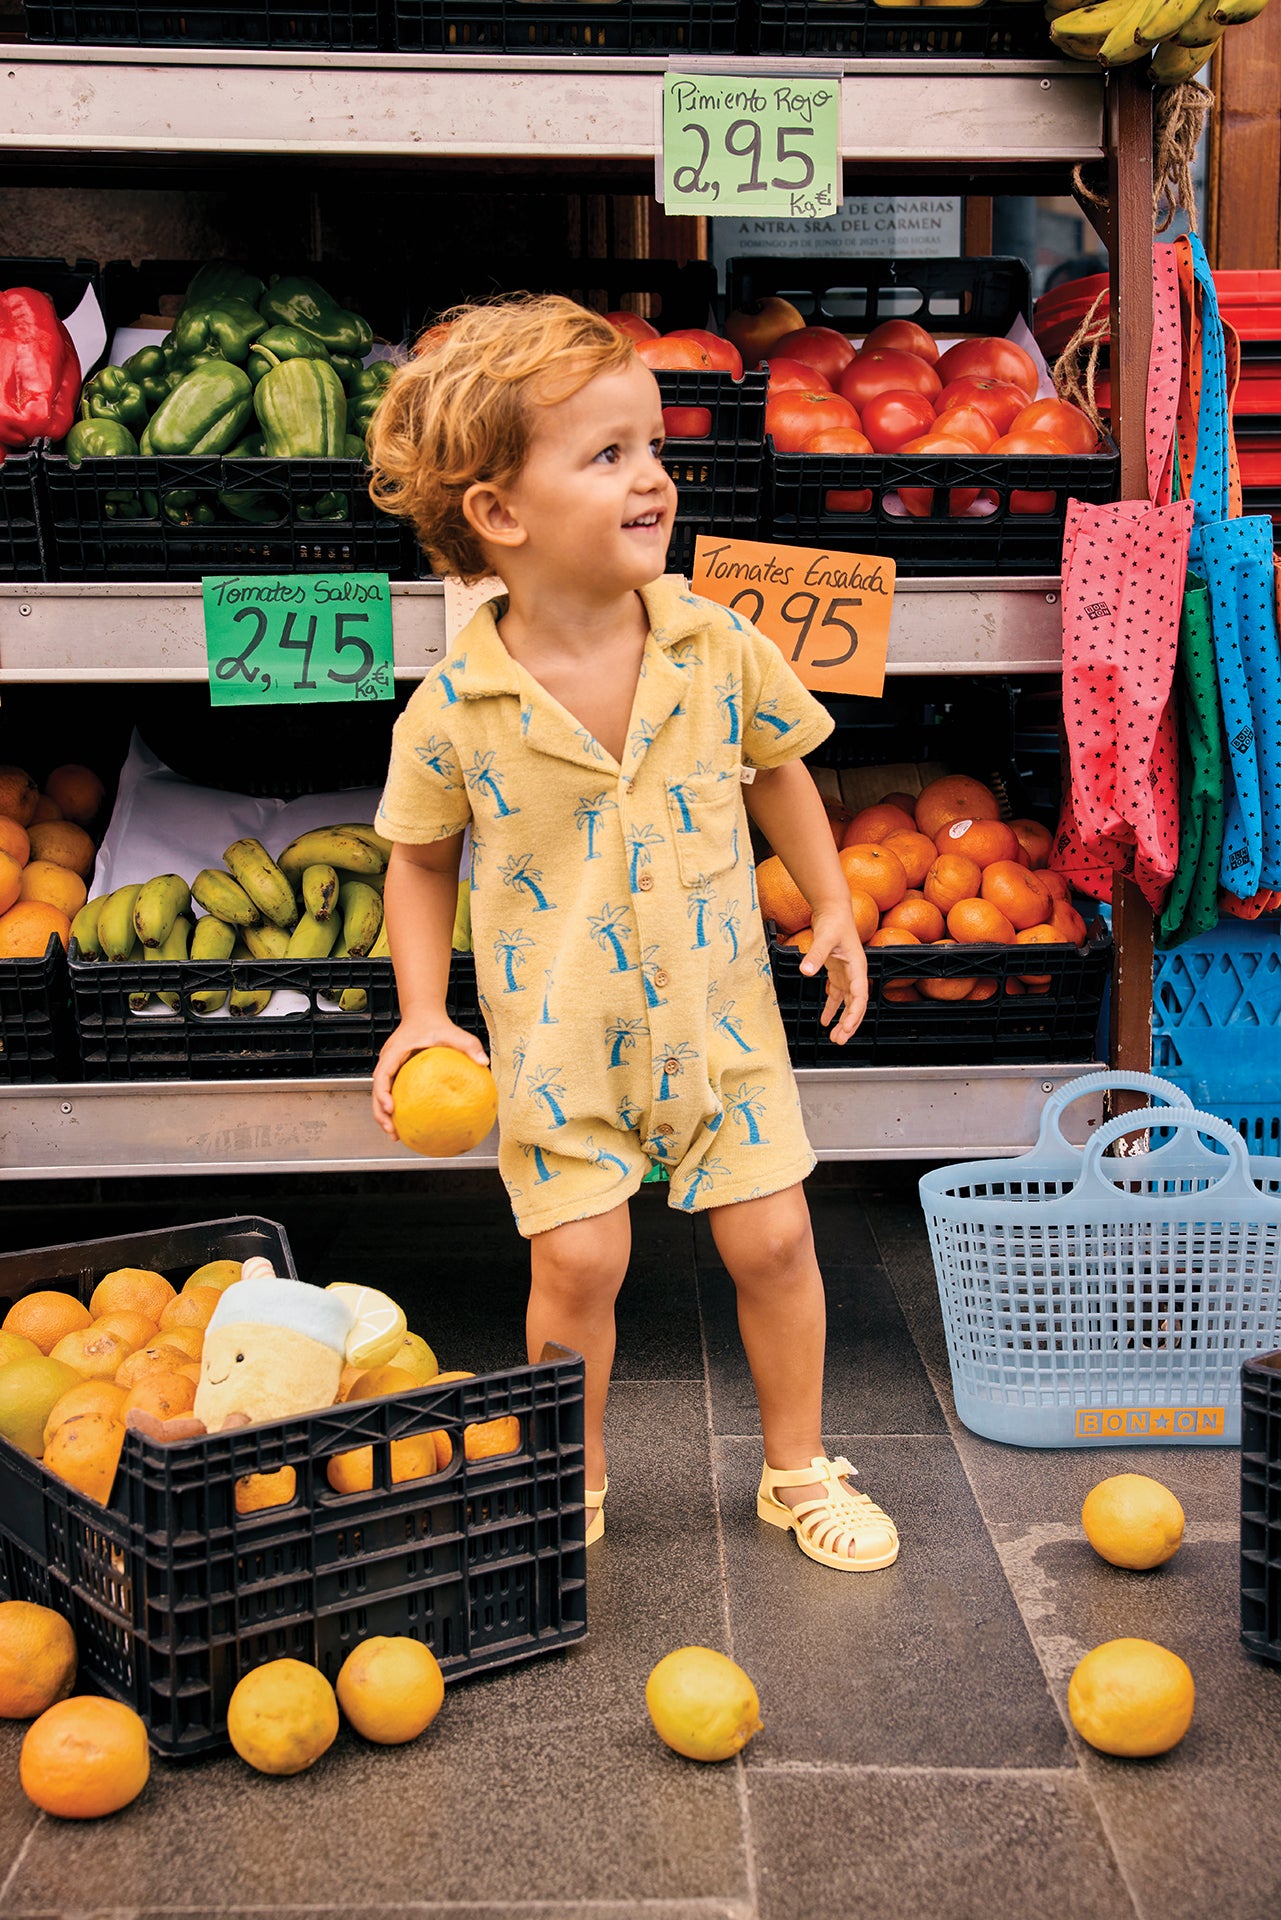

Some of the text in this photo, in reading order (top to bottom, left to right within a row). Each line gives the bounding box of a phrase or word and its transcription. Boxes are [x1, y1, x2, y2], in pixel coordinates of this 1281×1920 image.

[671, 81, 833, 122] Pimiento Rojo
[673, 119, 815, 201] 2,95
[738, 221, 750, 234] A
[841, 219, 871, 232] DEL
[874, 217, 943, 231] CARMEN
[848, 202, 869, 215] DE
[873, 200, 954, 215] CANARIAS
[703, 545, 889, 595] Tomates Ensalada
[212, 577, 383, 606] Tomates Salsa
[215, 606, 375, 692] 2,45
